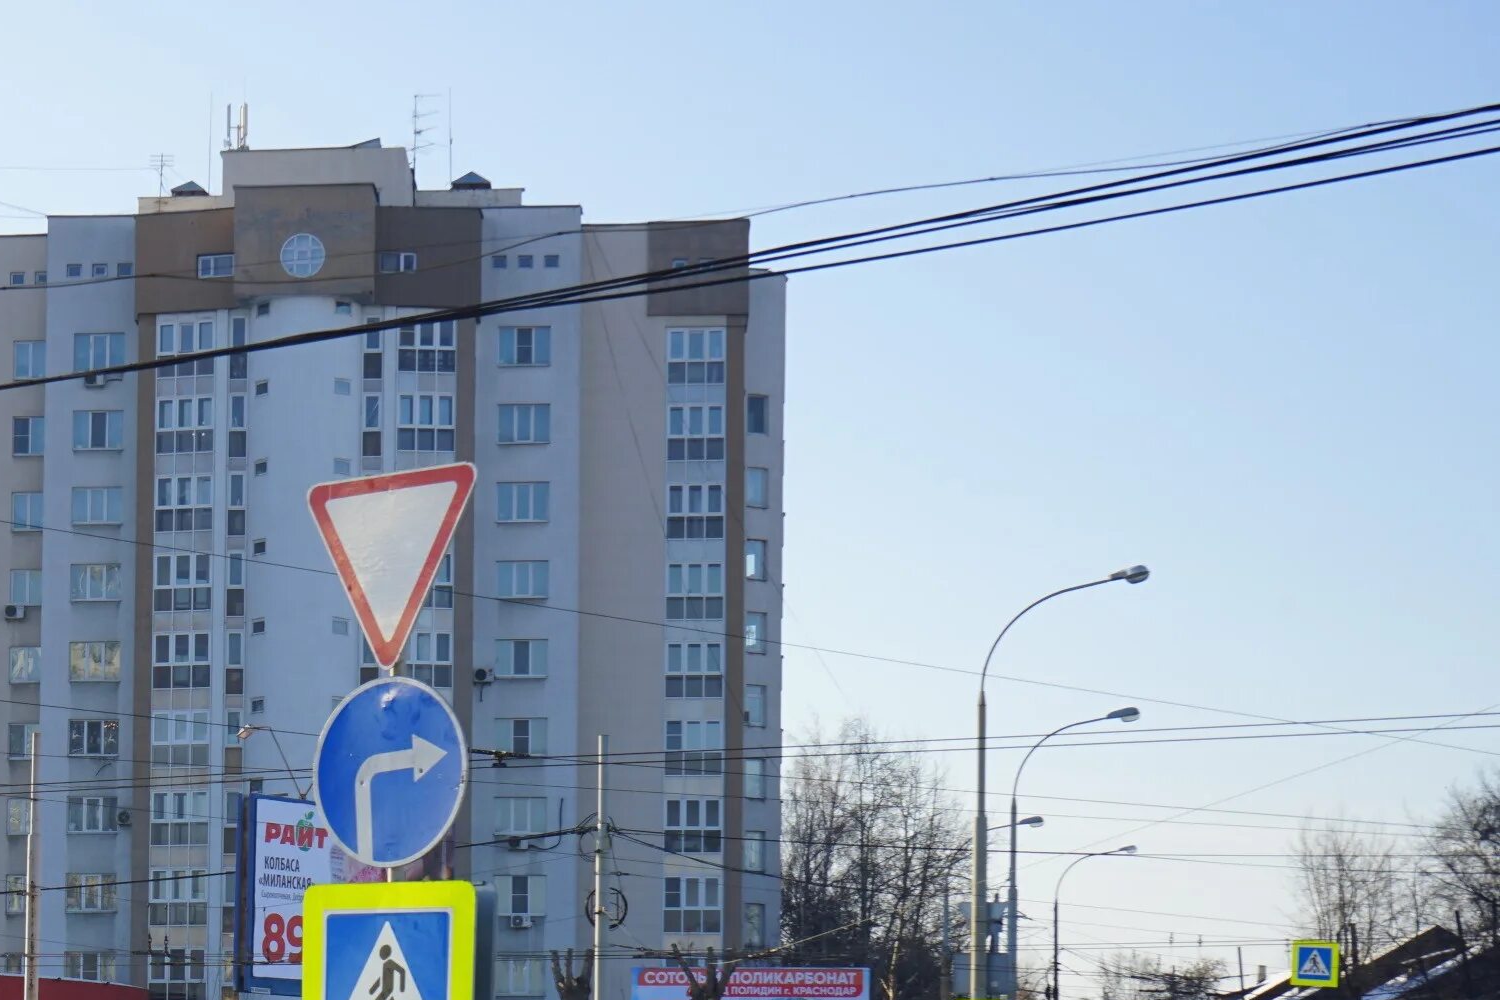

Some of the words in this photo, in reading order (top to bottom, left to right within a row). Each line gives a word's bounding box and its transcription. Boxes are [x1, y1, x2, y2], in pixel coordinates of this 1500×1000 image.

[264, 856, 300, 872] КОЛБАСА
[730, 971, 856, 985] ПОЛИКАРБОНАТ
[793, 986, 857, 996] КРАСНОДАР
